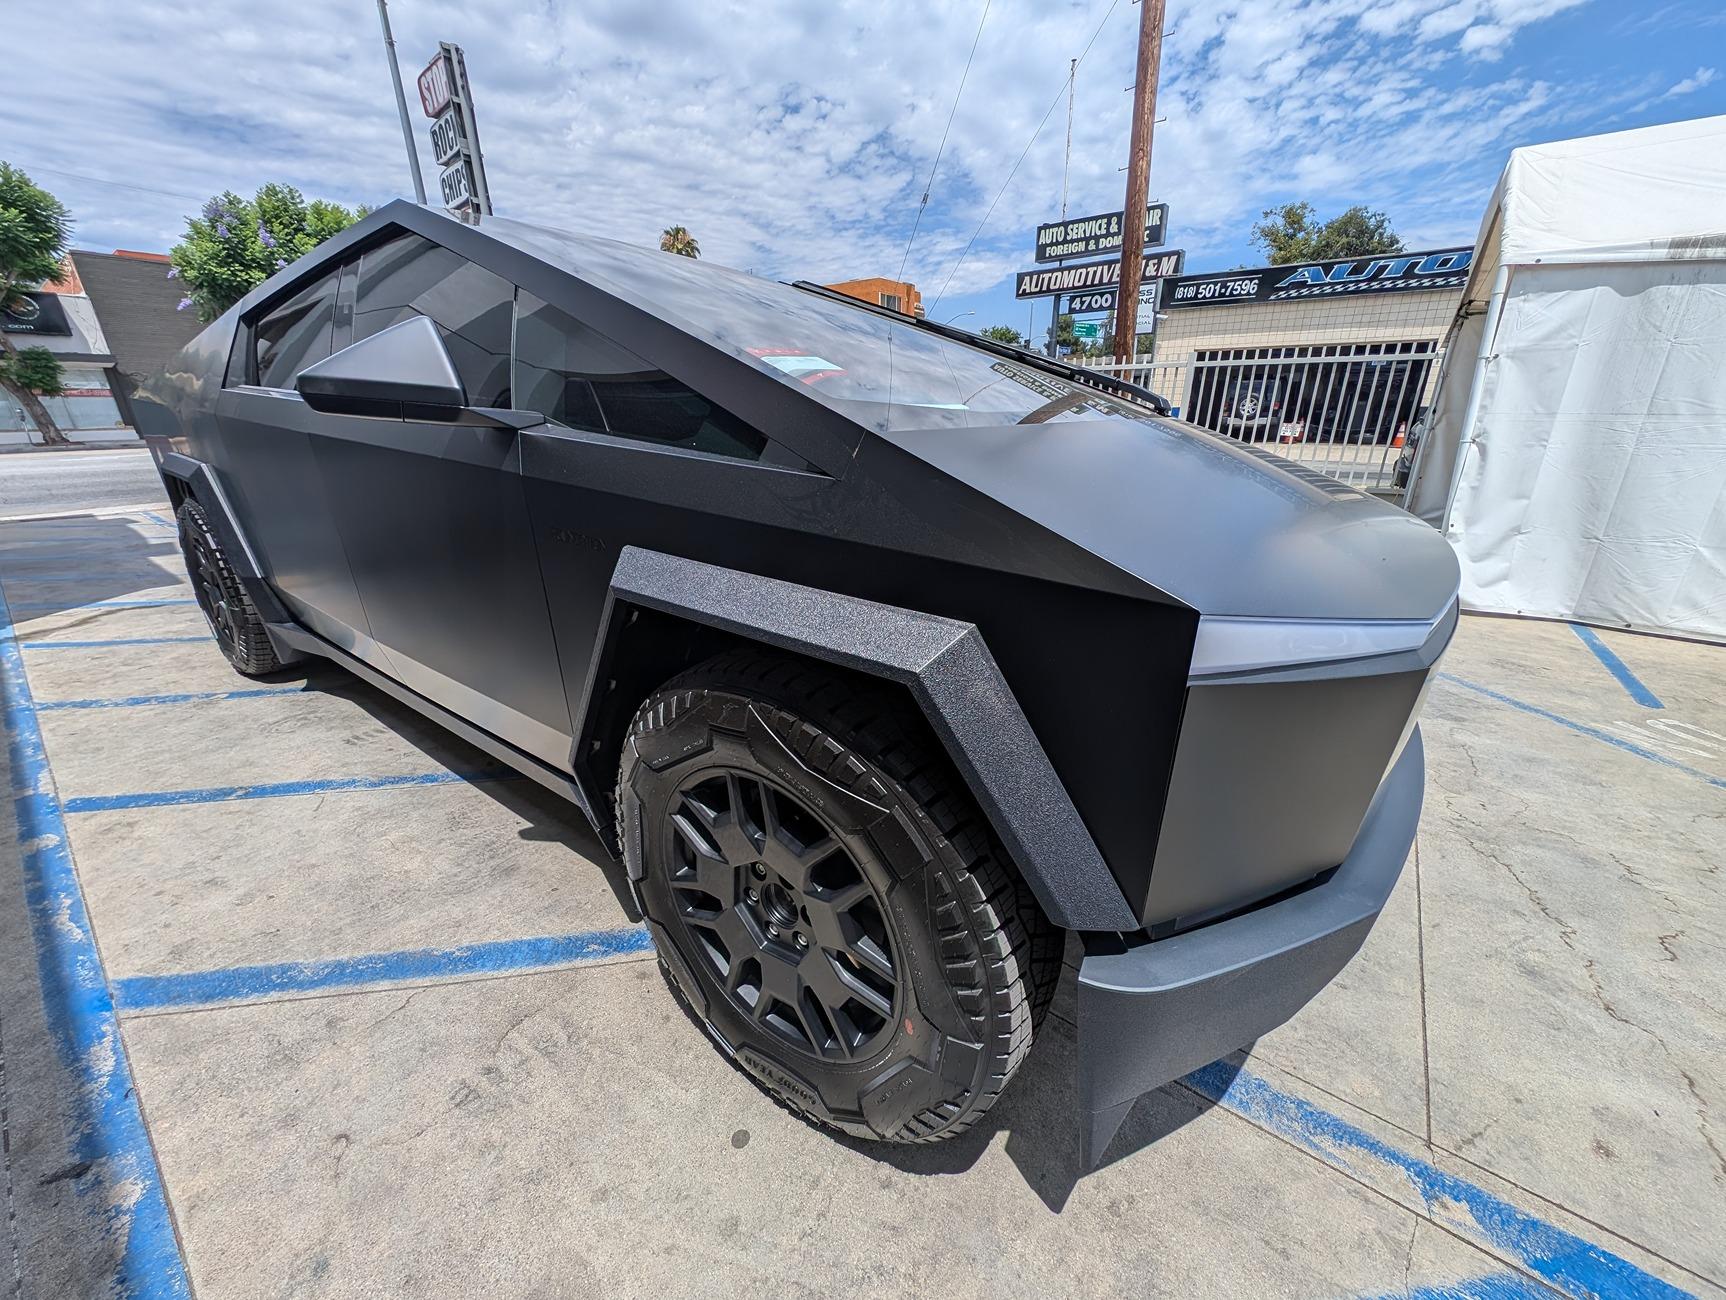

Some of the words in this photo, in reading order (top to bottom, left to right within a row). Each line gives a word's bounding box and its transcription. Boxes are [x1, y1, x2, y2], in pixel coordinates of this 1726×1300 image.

[1038, 226, 1065, 245] AUTO
[1066, 218, 1108, 240] SERVICE
[1109, 216, 1119, 233] &
[1045, 240, 1086, 257] FOREIGN
[1087, 239, 1096, 250] &
[1018, 263, 1121, 294] AUTOMOTIVE
[1273, 250, 1473, 288] AUTO
[1174, 286, 1197, 299] (818)
[1197, 279, 1260, 299] 501-7596
[1071, 293, 1113, 310] 4700
